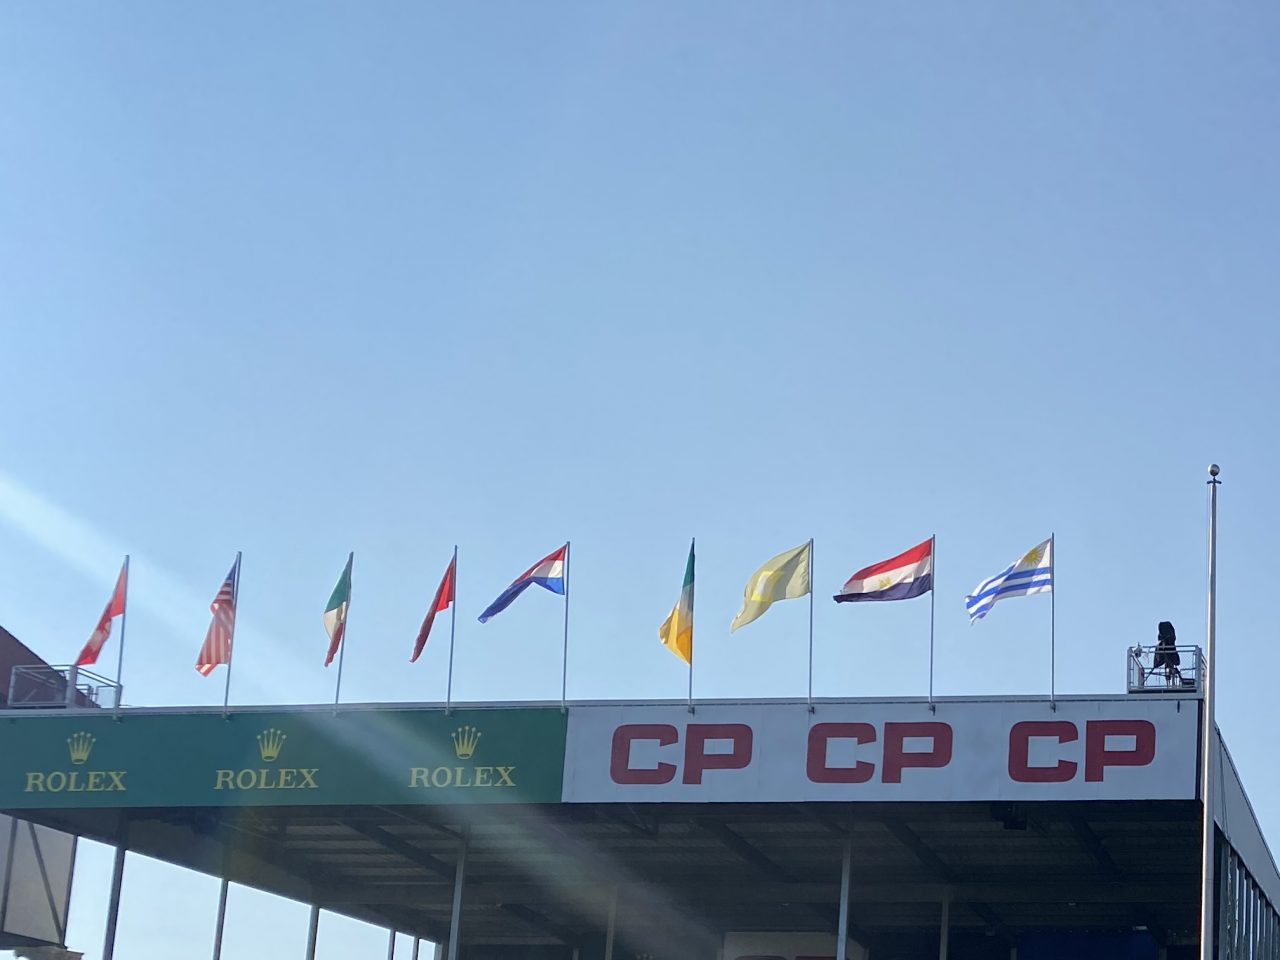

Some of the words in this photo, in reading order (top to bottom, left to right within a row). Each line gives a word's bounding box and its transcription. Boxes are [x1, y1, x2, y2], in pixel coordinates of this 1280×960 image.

[610, 723, 753, 785] CP
[807, 721, 953, 784] CP
[1009, 719, 1156, 782] CP
[24, 771, 127, 792] ROLEX
[214, 768, 319, 790] ROLEX
[408, 766, 516, 788] ROLEX
